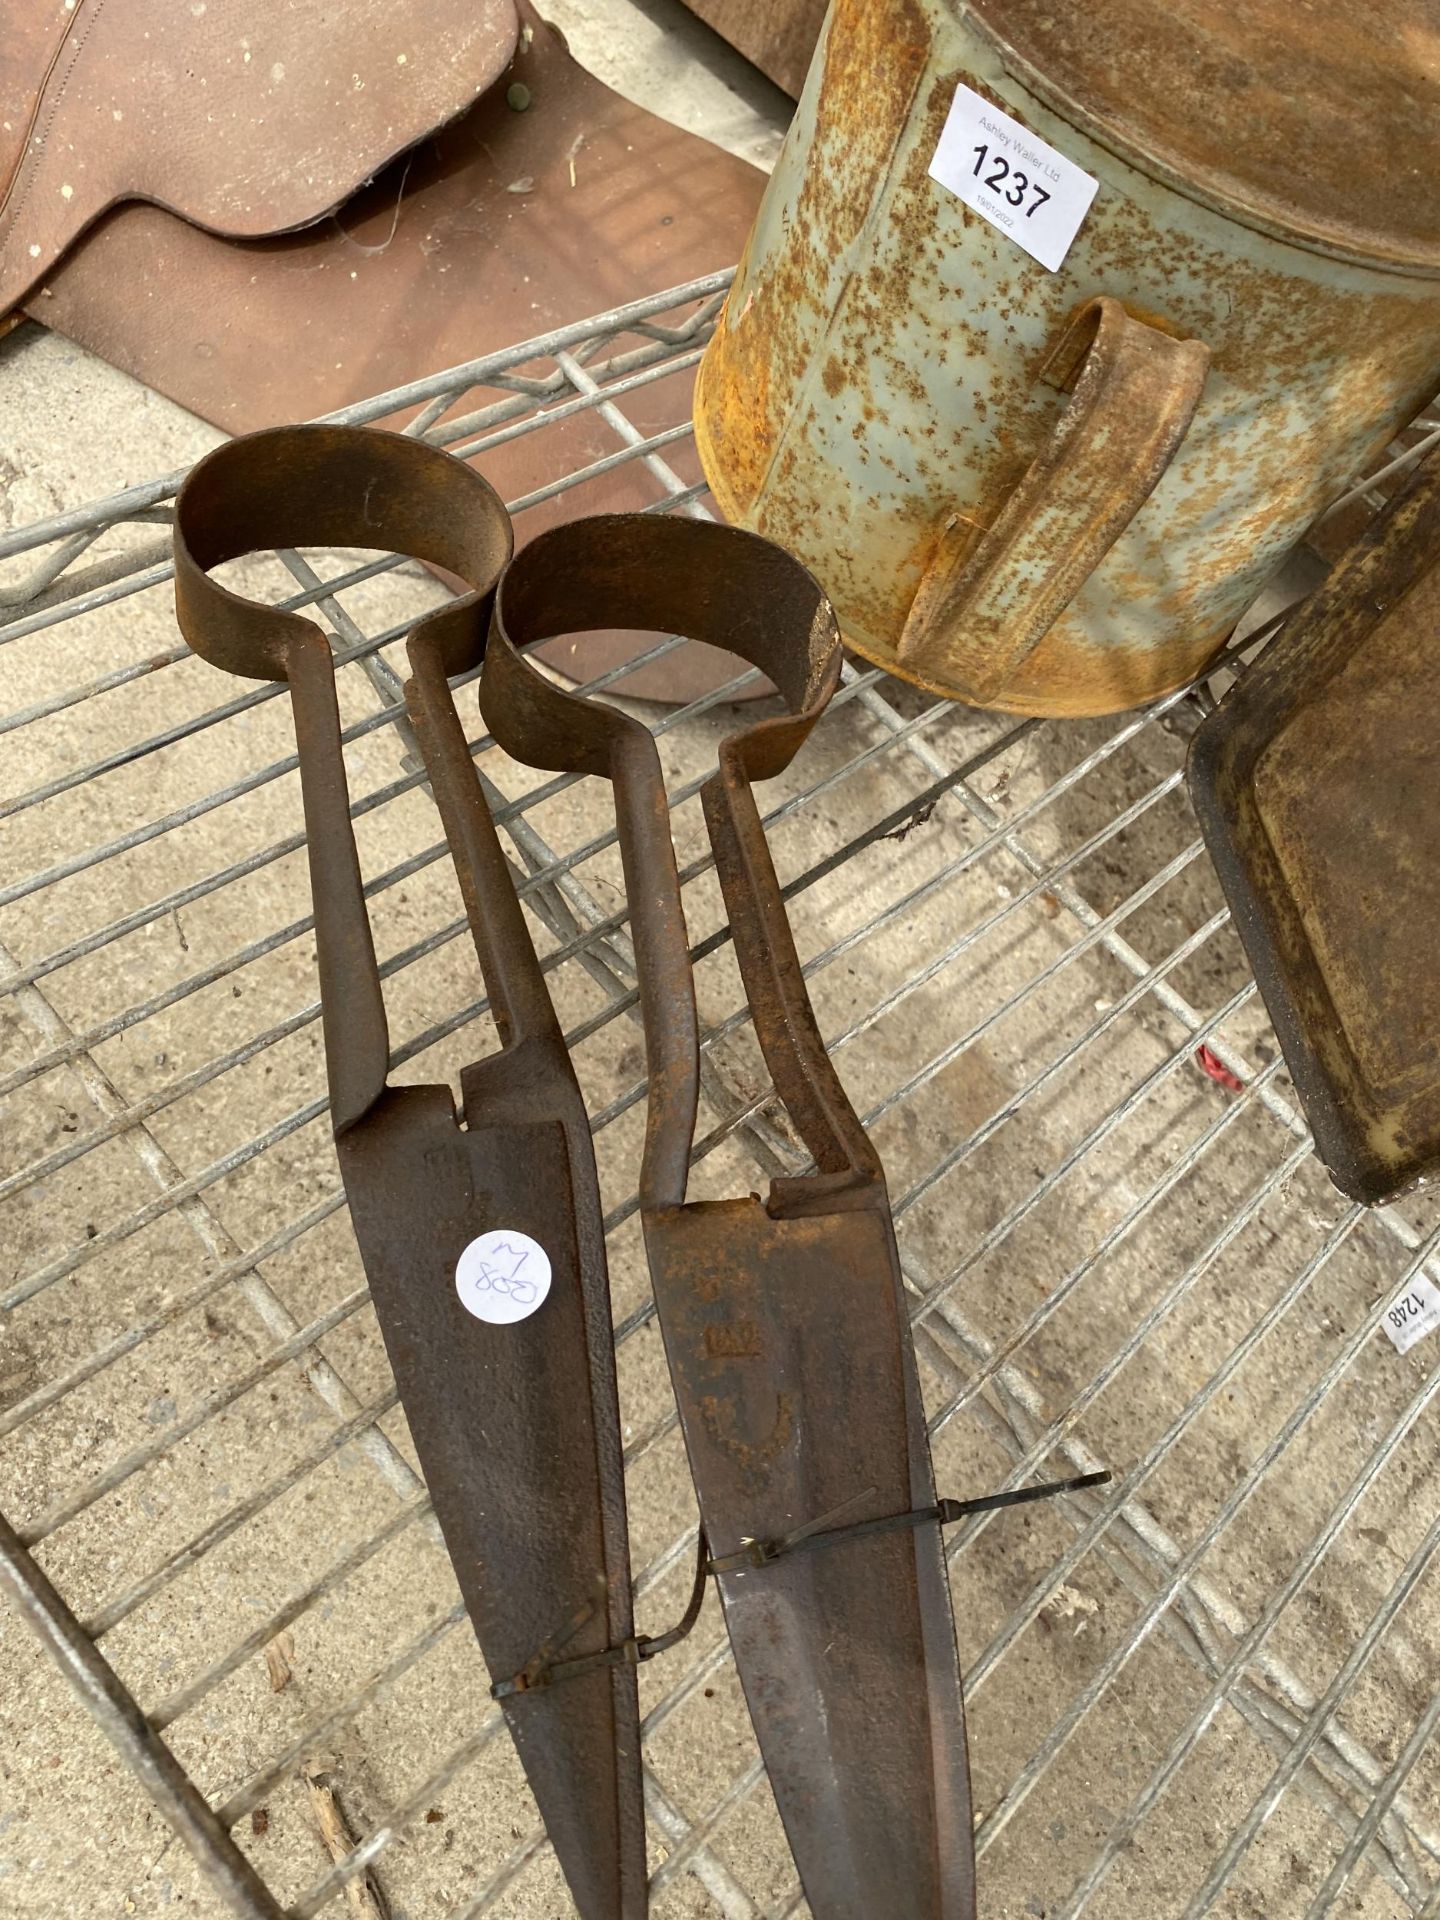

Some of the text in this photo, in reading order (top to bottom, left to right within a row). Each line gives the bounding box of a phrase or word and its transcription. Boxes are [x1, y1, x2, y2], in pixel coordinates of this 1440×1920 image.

[977, 116, 1062, 183] Ashley Waller Ltd
[972, 143, 1051, 218] 1237
[976, 194, 1015, 229] 19/01/2022
[1388, 1292, 1425, 1328] 1248
